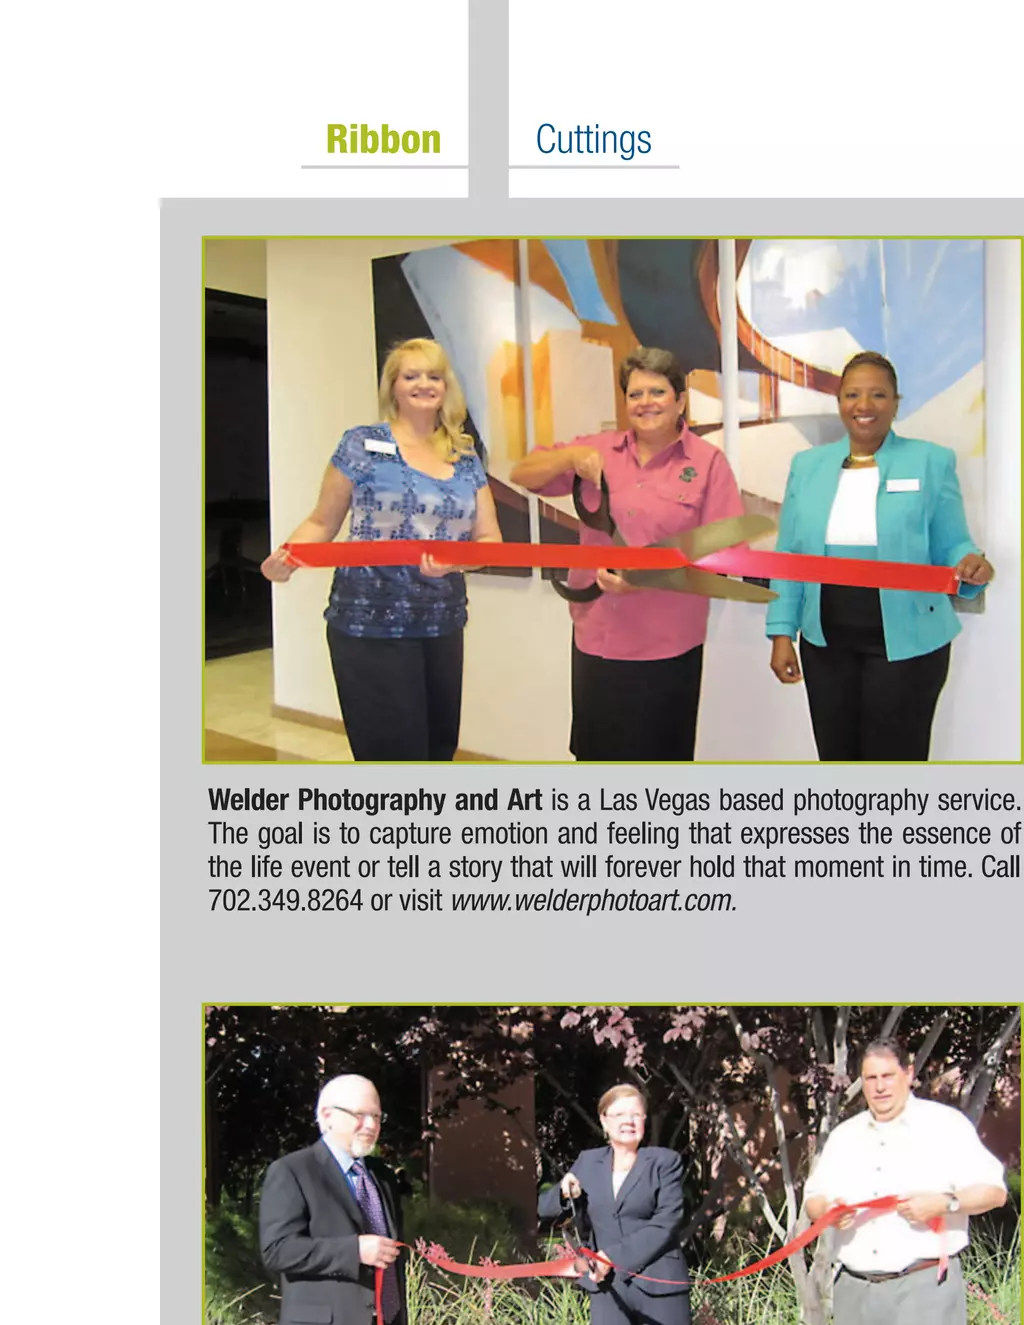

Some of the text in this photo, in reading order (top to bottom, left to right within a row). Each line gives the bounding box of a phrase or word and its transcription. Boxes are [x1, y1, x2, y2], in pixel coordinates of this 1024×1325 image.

[326, 122, 652, 161] Ribbon Cuttings
[207, 787, 1021, 817] Welder Photography and Art is a Las Vegas based photography service.
[208, 888, 737, 917] 702.349.8264 or visit www.welderphotoart.com.
